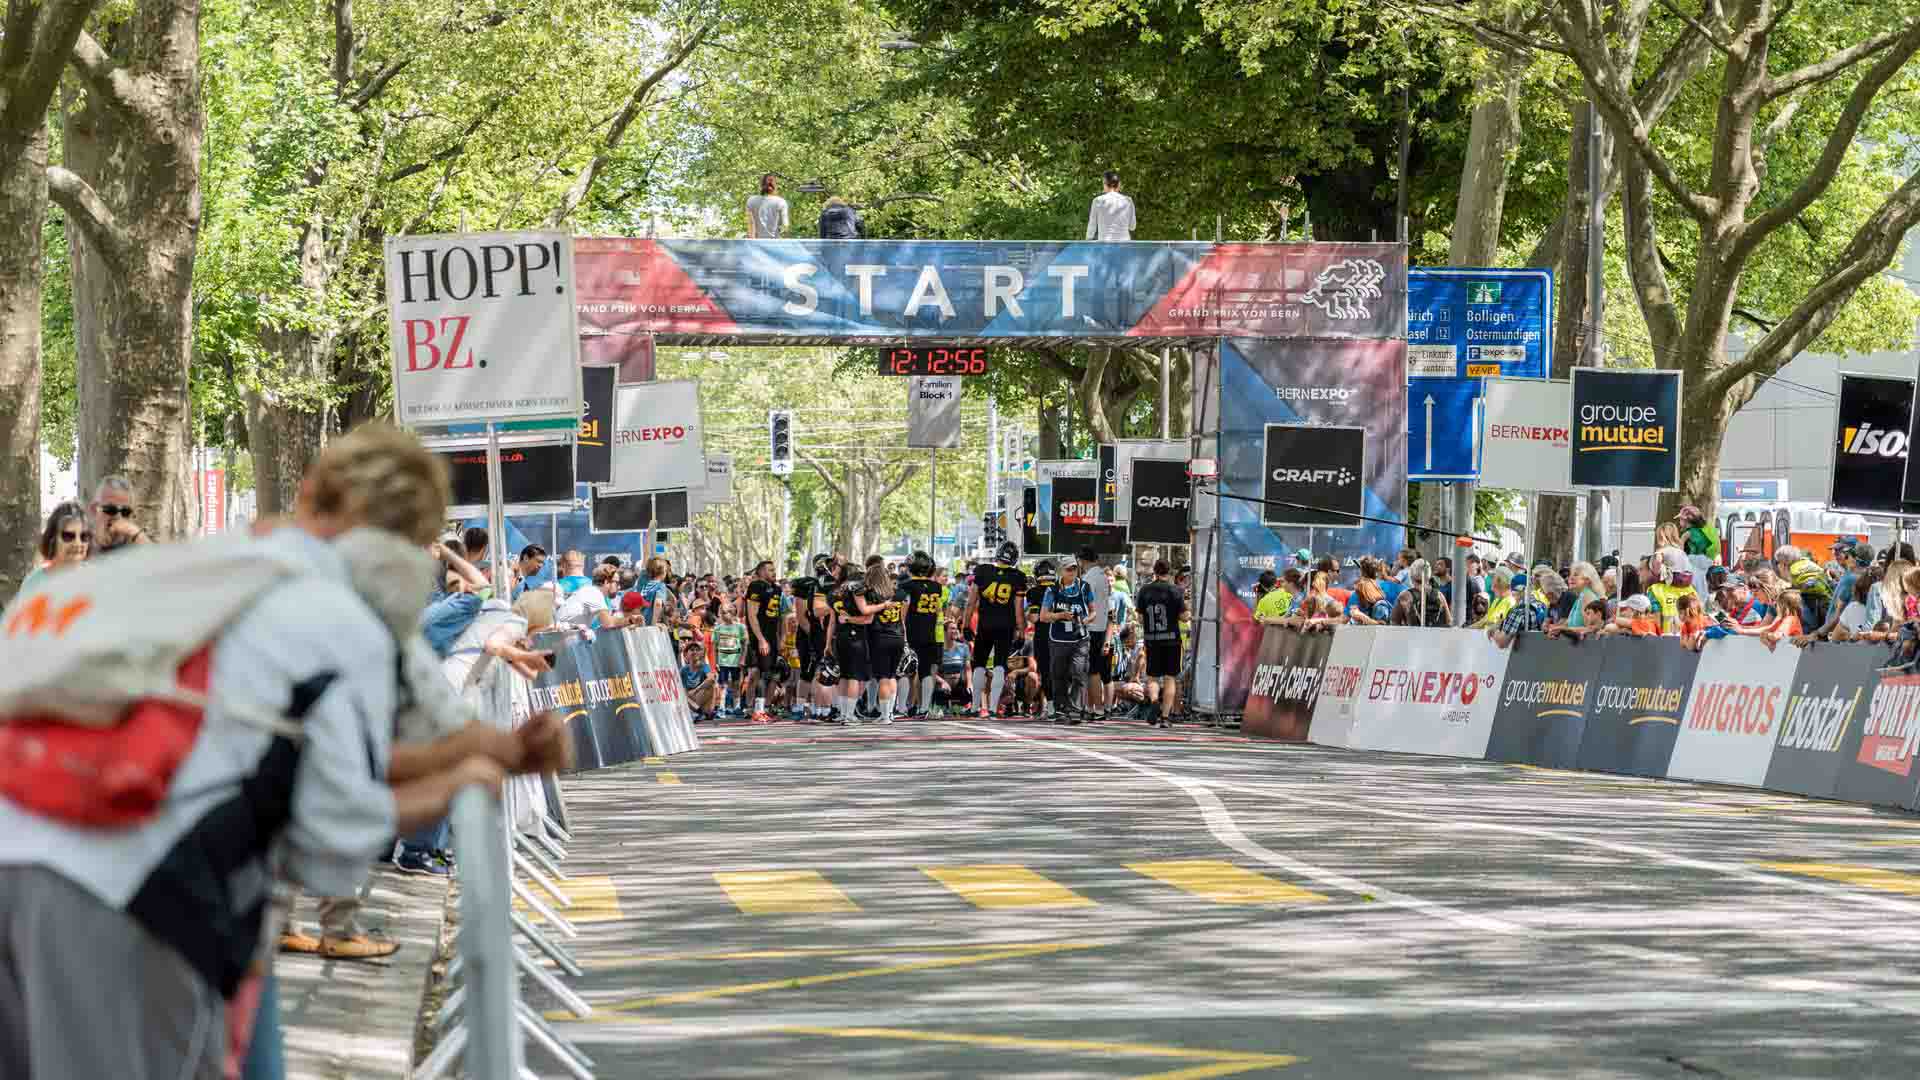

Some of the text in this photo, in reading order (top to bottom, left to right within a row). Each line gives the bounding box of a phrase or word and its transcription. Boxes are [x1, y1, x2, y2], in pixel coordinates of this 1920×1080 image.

[397, 240, 564, 303] HOPP!
[783, 263, 1089, 318] START
[576, 304, 606, 313] RAND
[640, 304, 665, 313] VON
[1168, 309, 1300, 318] GRAND PRIX VON BERN
[1408, 308, 1433, 322] ürich
[1466, 309, 1515, 325] Bolligen
[1408, 327, 1429, 340] asel
[1466, 328, 1540, 343] Ostermundigen
[401, 315, 487, 372] BZ.
[890, 349, 985, 374] 12:12:56
[920, 391, 945, 399] Block
[1276, 387, 1349, 400] BERNEXPO
[1580, 404, 1657, 425] groupe
[616, 425, 685, 445] ERNEXPO
[1581, 425, 1665, 444] mutuel
[1272, 468, 1338, 483] CRAFT
[1137, 496, 1191, 509] CRAFT
[981, 581, 1012, 604] 49
[1368, 668, 1480, 705] BERNEXPO
[1688, 682, 1781, 734] MIGROS
[1780, 682, 1854, 751] isostar
